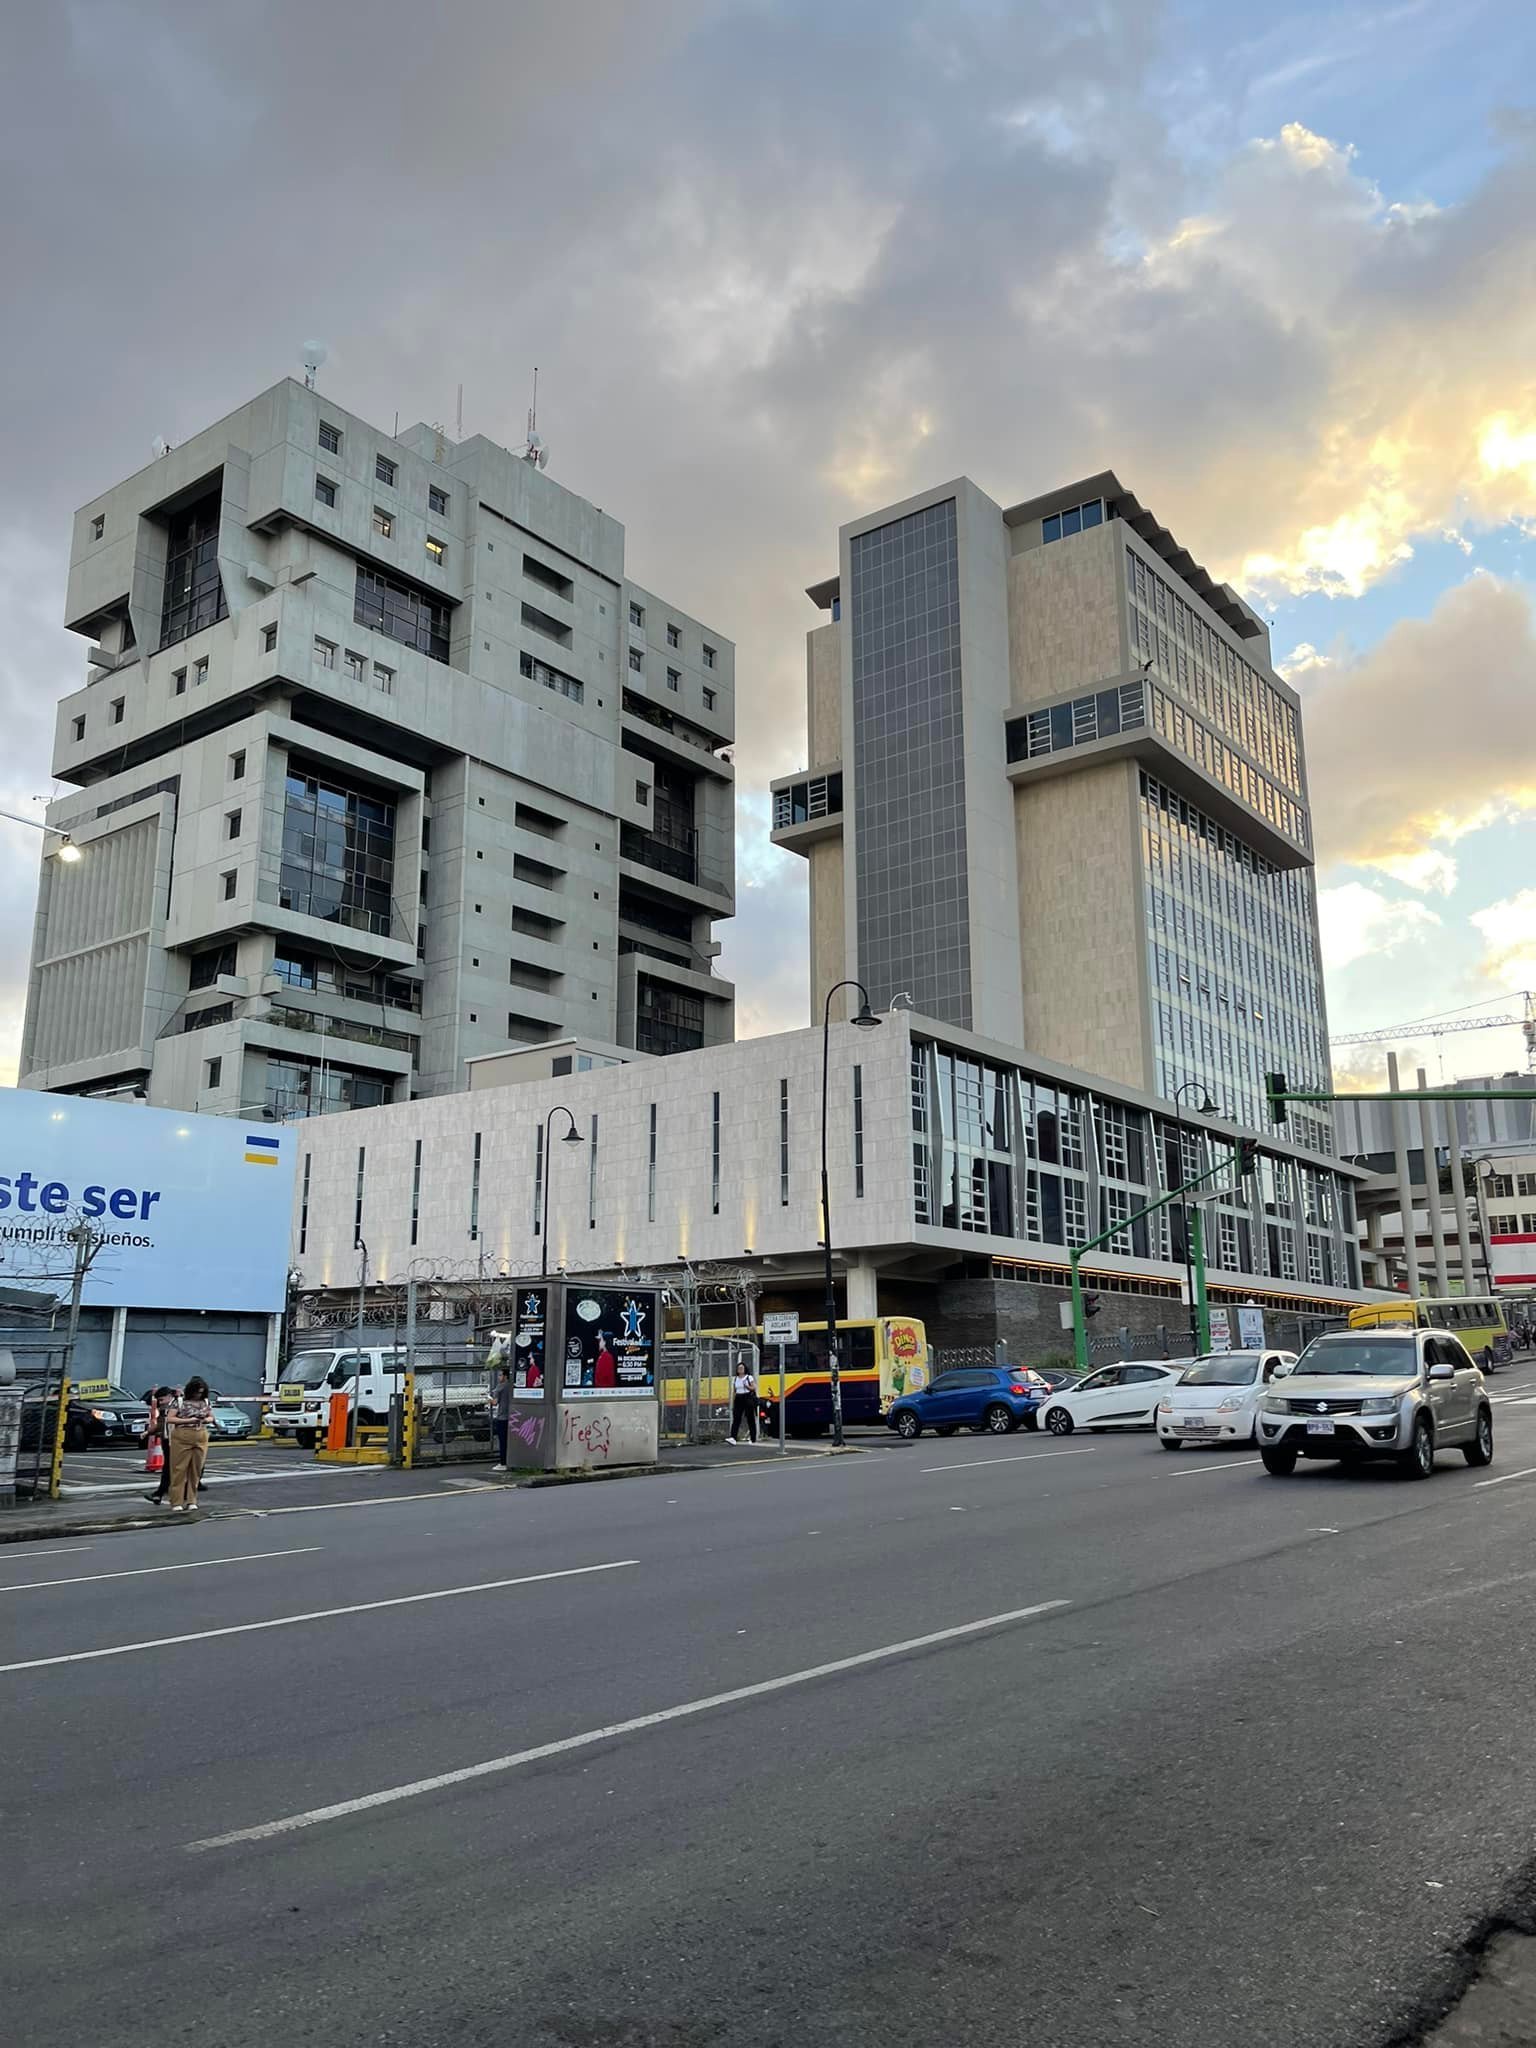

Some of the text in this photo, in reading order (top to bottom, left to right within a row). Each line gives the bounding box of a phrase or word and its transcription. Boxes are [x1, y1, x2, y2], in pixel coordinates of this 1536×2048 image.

[82, 1185, 161, 1220] ser
[0, 1226, 55, 1243] umplí
[91, 1231, 155, 1248] sueños.
[81, 1384, 109, 1394] ENTRADA
